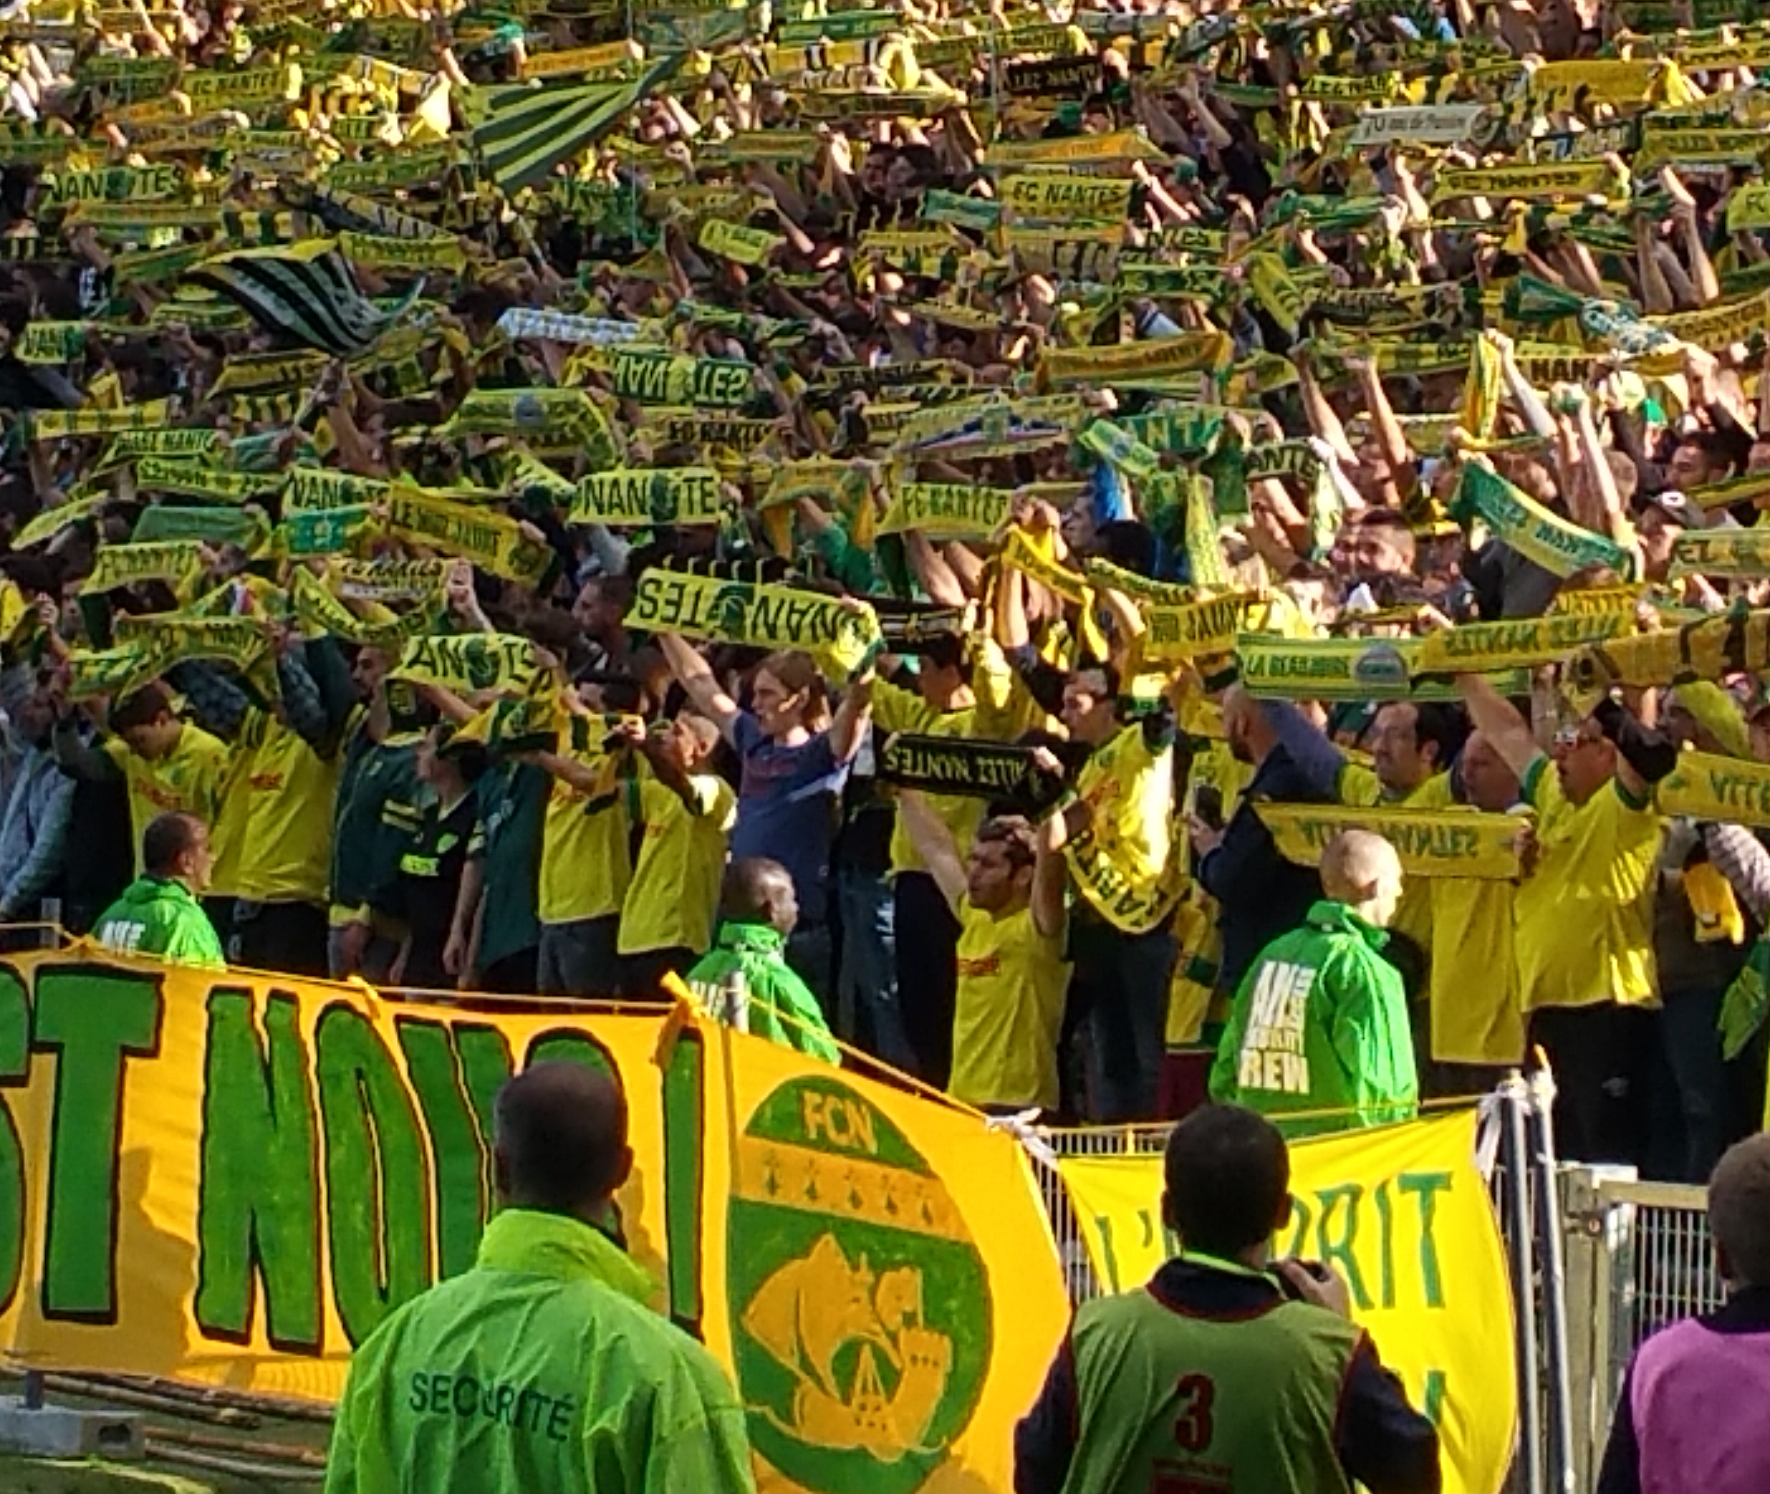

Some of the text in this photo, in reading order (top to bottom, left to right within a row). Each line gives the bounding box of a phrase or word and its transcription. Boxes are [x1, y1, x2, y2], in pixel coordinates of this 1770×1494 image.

[1012, 181, 1126, 206] FC NANTES
[1746, 193, 1767, 214] FC
[802, 1088, 881, 1158] FCN
[194, 984, 629, 1356] NOU
[1174, 1372, 1216, 1452] 3
